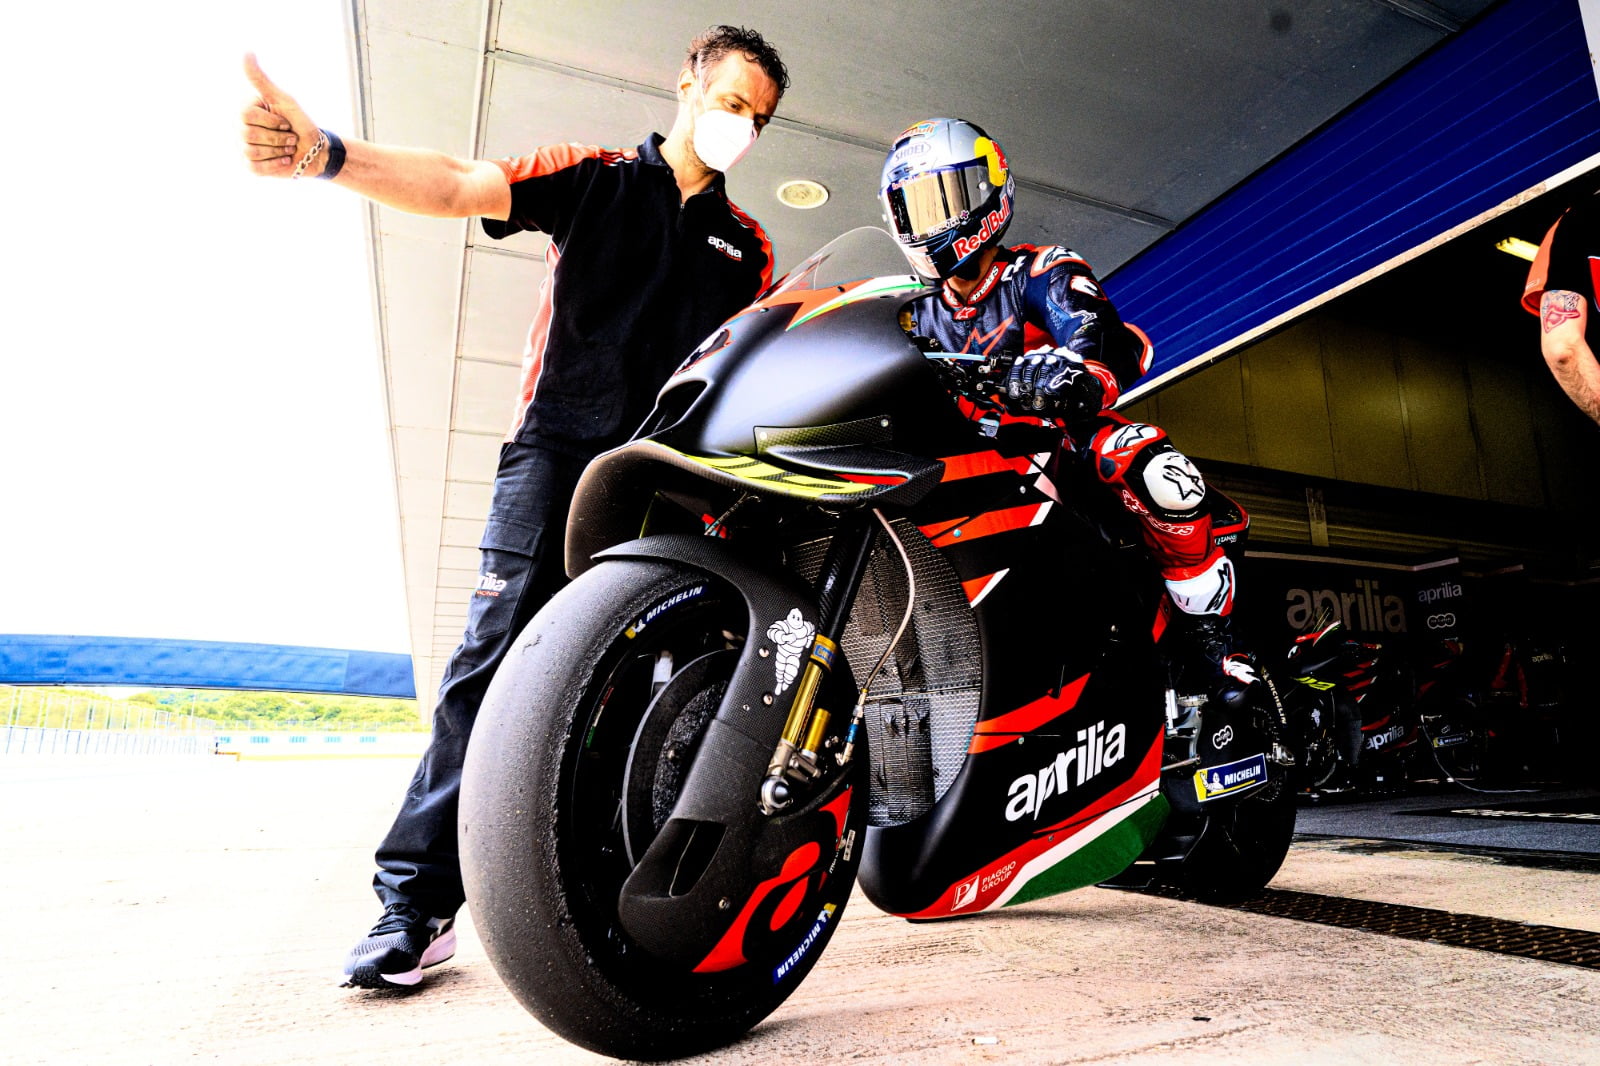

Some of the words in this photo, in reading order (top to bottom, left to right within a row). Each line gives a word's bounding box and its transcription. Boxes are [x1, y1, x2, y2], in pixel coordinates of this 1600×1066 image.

[896, 144, 924, 161] SHOEI
[708, 235, 742, 258] aprilia
[646, 586, 703, 622] MICHELIN
[1286, 578, 1407, 633] aprilia
[1417, 581, 1463, 605] aprilia
[1267, 679, 1287, 725] MICHELIN
[1365, 724, 1404, 750] aprilia
[1004, 719, 1127, 822] aprilia
[1224, 764, 1261, 786] MICHELIN
[981, 870, 1012, 893] GROUP
[982, 860, 1017, 886] PIAGGIO
[776, 922, 822, 978] MICHELIN
